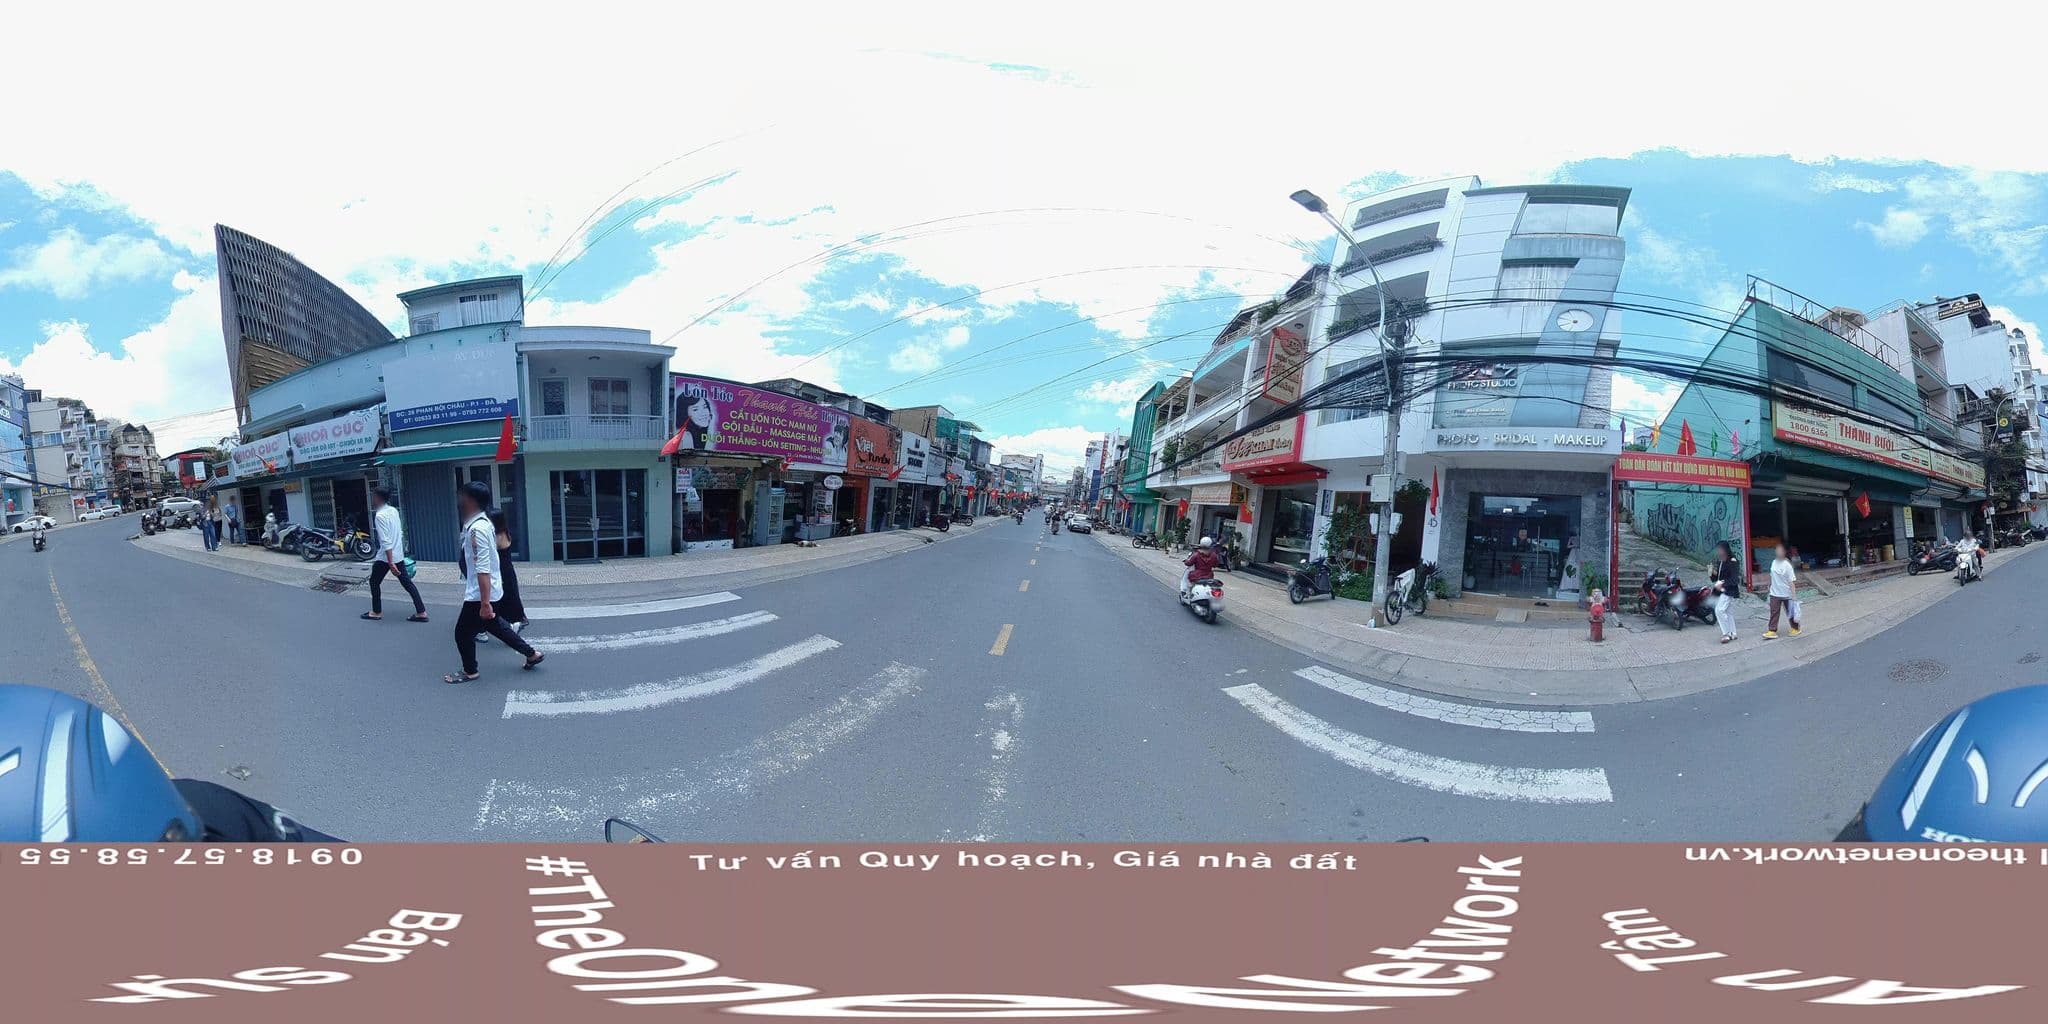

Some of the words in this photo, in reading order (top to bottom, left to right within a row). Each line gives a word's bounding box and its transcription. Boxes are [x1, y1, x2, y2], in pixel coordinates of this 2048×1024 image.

[1480, 378, 1517, 388] STUDIO
[730, 408, 749, 420] CẮT
[751, 412, 769, 424] UỐN
[771, 415, 787, 427] TÓC
[788, 420, 806, 431] NAM
[722, 421, 740, 432] GỘI
[743, 422, 762, 434] ĐẦU
[769, 427, 806, 441] MASSAGE
[1493, 432, 1537, 445] BRIDAL
[1553, 433, 1608, 447] MAKEUP
[1838, 422, 1872, 445] THÀNH
[761, 437, 779, 449] UỐN
[780, 441, 807, 452] SETTING
